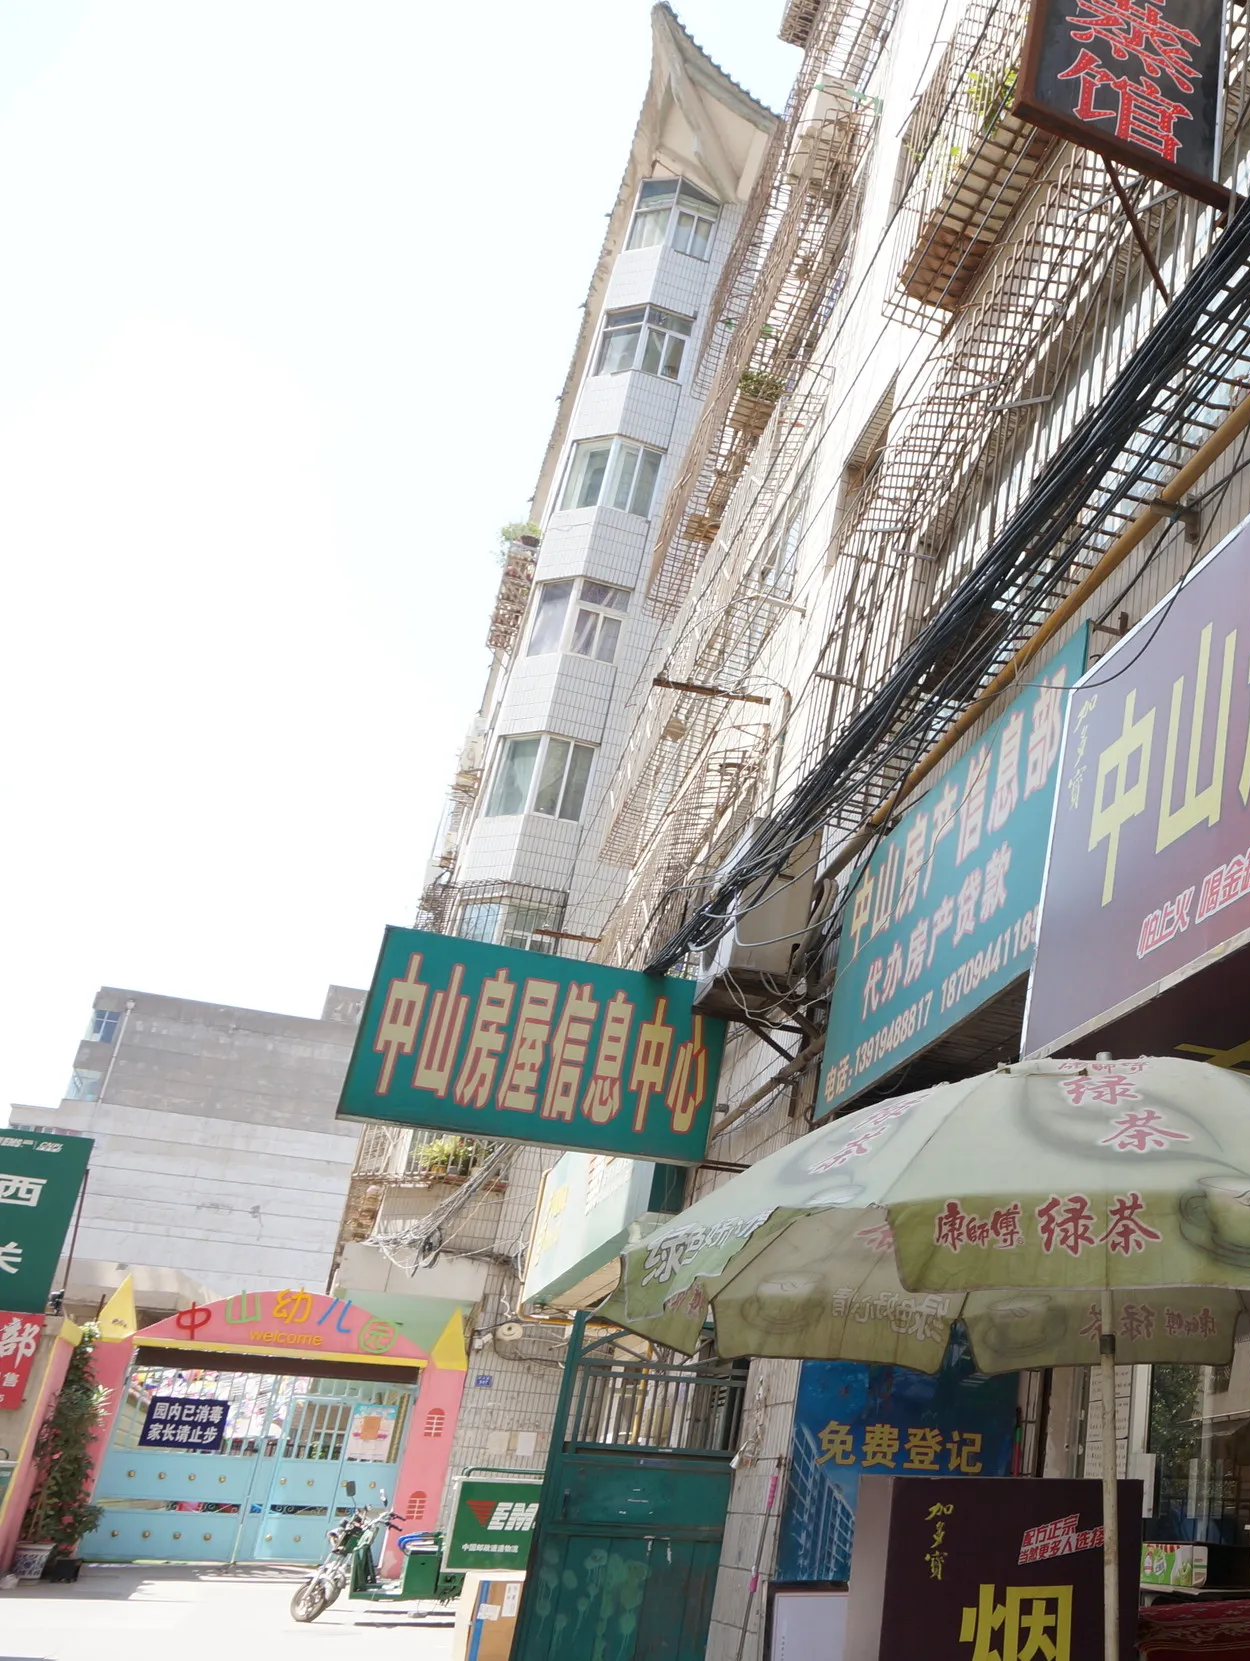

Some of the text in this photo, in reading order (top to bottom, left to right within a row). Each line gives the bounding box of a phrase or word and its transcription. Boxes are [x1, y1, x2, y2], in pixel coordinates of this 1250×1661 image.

[848, 664, 1070, 961] 中山房产信息部
[860, 840, 1014, 1023] 代办房产贷款
[1136, 886, 1196, 959] 怕上火
[372, 952, 708, 1136] 中山房屋信息中心
[1036, 1193, 1162, 1257] 绿茶
[175, 1287, 401, 1354] 中山幼儿园
[250, 1328, 323, 1346] welcome
[146, 1422, 219, 1445] 家长请止步
[152, 1402, 224, 1425] 园内已消毒
[815, 1420, 984, 1474] 免费登记
[487, 1501, 540, 1532] EM
[1022, 1513, 1081, 1548] 配方正宗
[958, 1583, 1074, 1661] 烟
